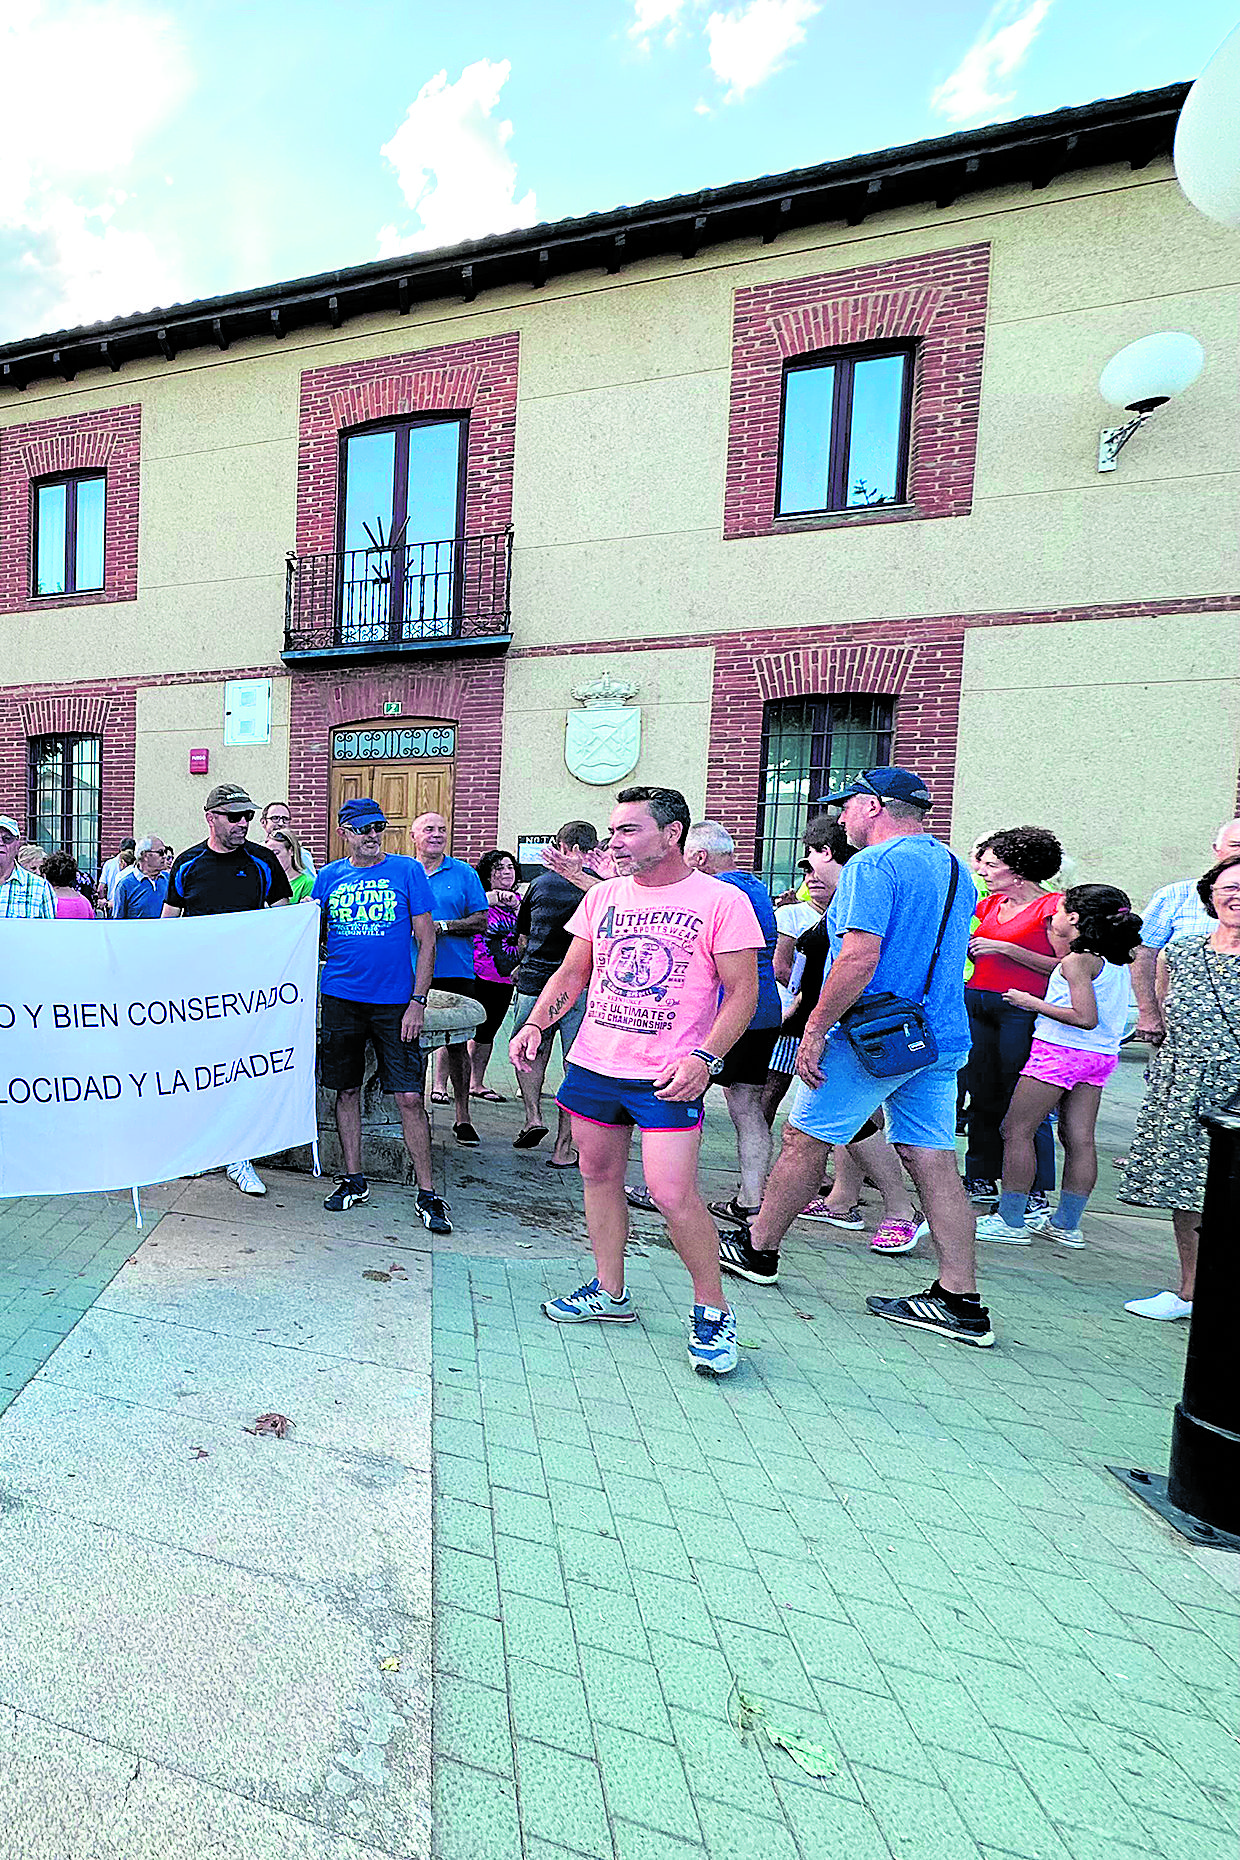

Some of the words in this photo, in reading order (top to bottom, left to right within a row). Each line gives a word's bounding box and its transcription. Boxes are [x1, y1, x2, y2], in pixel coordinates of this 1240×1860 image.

[329, 889, 396, 910] SOUND
[329, 901, 397, 922] TRACK
[597, 905, 703, 939] AUTHENTIC
[633, 926, 698, 941] SPORTSWEAR
[22, 1004, 44, 1029] Y
[52, 1002, 122, 1029] BIEN
[596, 1001, 608, 1012] THE
[609, 1003, 665, 1021] ULTIMATE
[607, 1013, 673, 1031] CHAMPIONSHIPS
[128, 1072, 148, 1098] Y
[155, 1069, 190, 1096] LA
[194, 1046, 295, 1092] DEJADEZ
